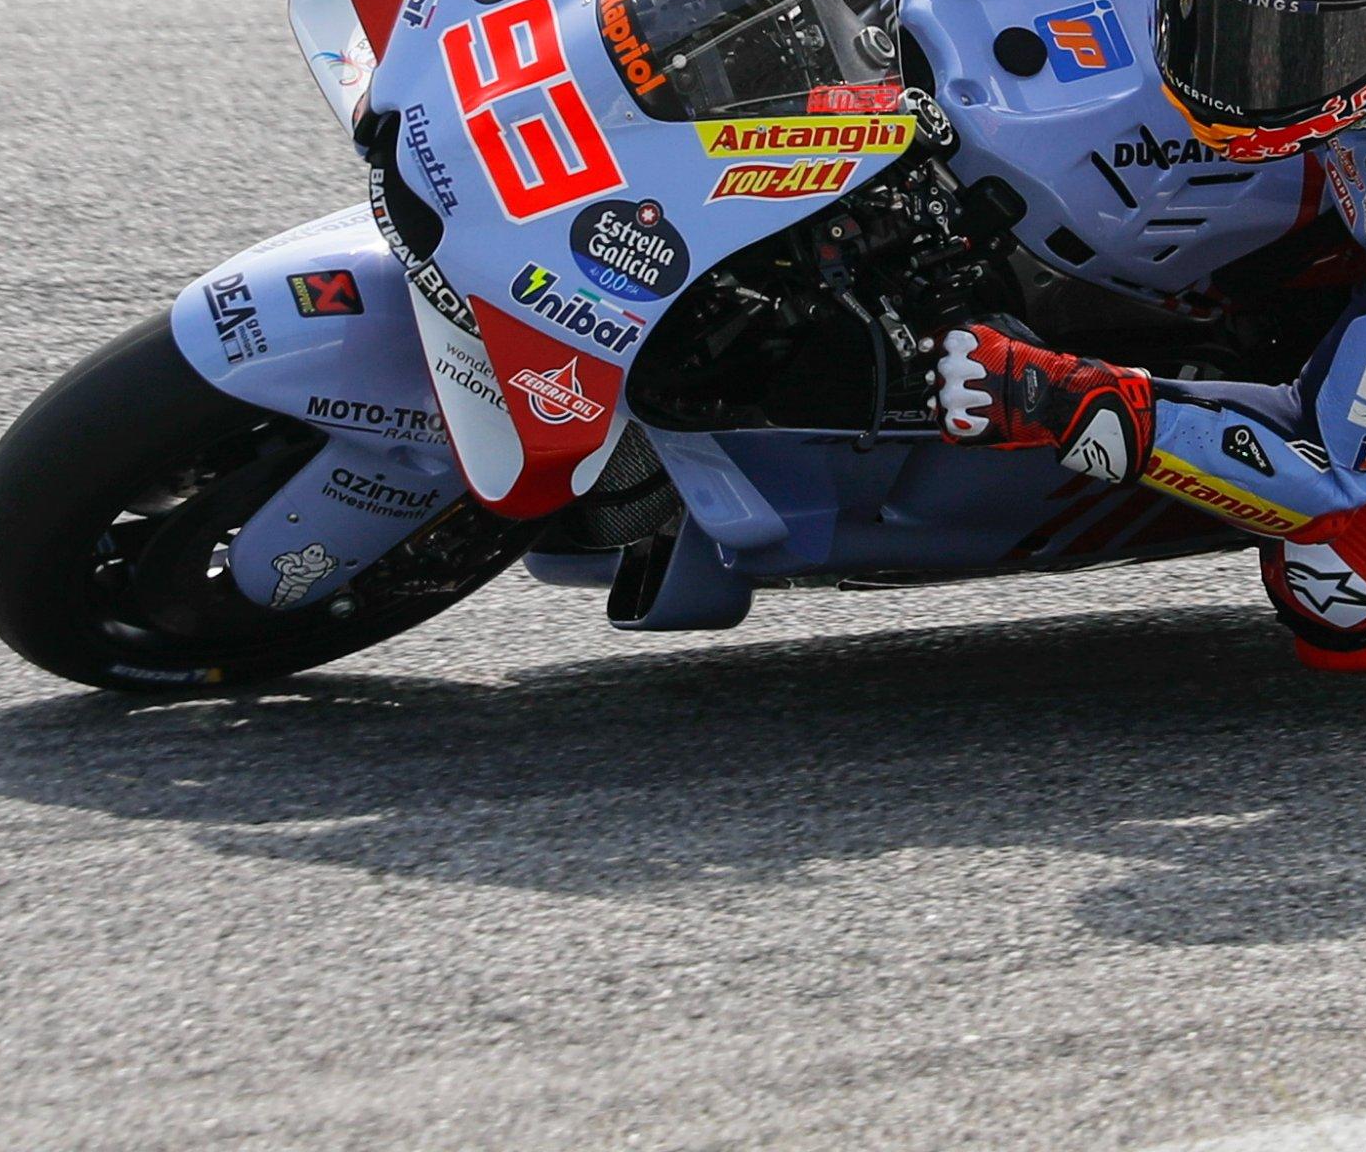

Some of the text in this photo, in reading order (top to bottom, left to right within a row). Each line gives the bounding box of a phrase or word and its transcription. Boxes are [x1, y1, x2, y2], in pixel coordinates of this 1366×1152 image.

[708, 119, 906, 154] Antangin
[1113, 136, 1227, 169] DUCA
[404, 103, 460, 217] Gigetta
[720, 159, 841, 195] YOU-ALL
[594, 210, 675, 266] Estrella
[588, 233, 660, 287] Galicia
[509, 260, 645, 356] Unibat
[245, 319, 268, 354] gate
[306, 395, 446, 432] MOTO-TRO
[518, 372, 596, 418] FEDERAL OIL
[382, 427, 451, 445] RACIN
[321, 482, 427, 519] investimenti
[331, 467, 440, 508] azimut
